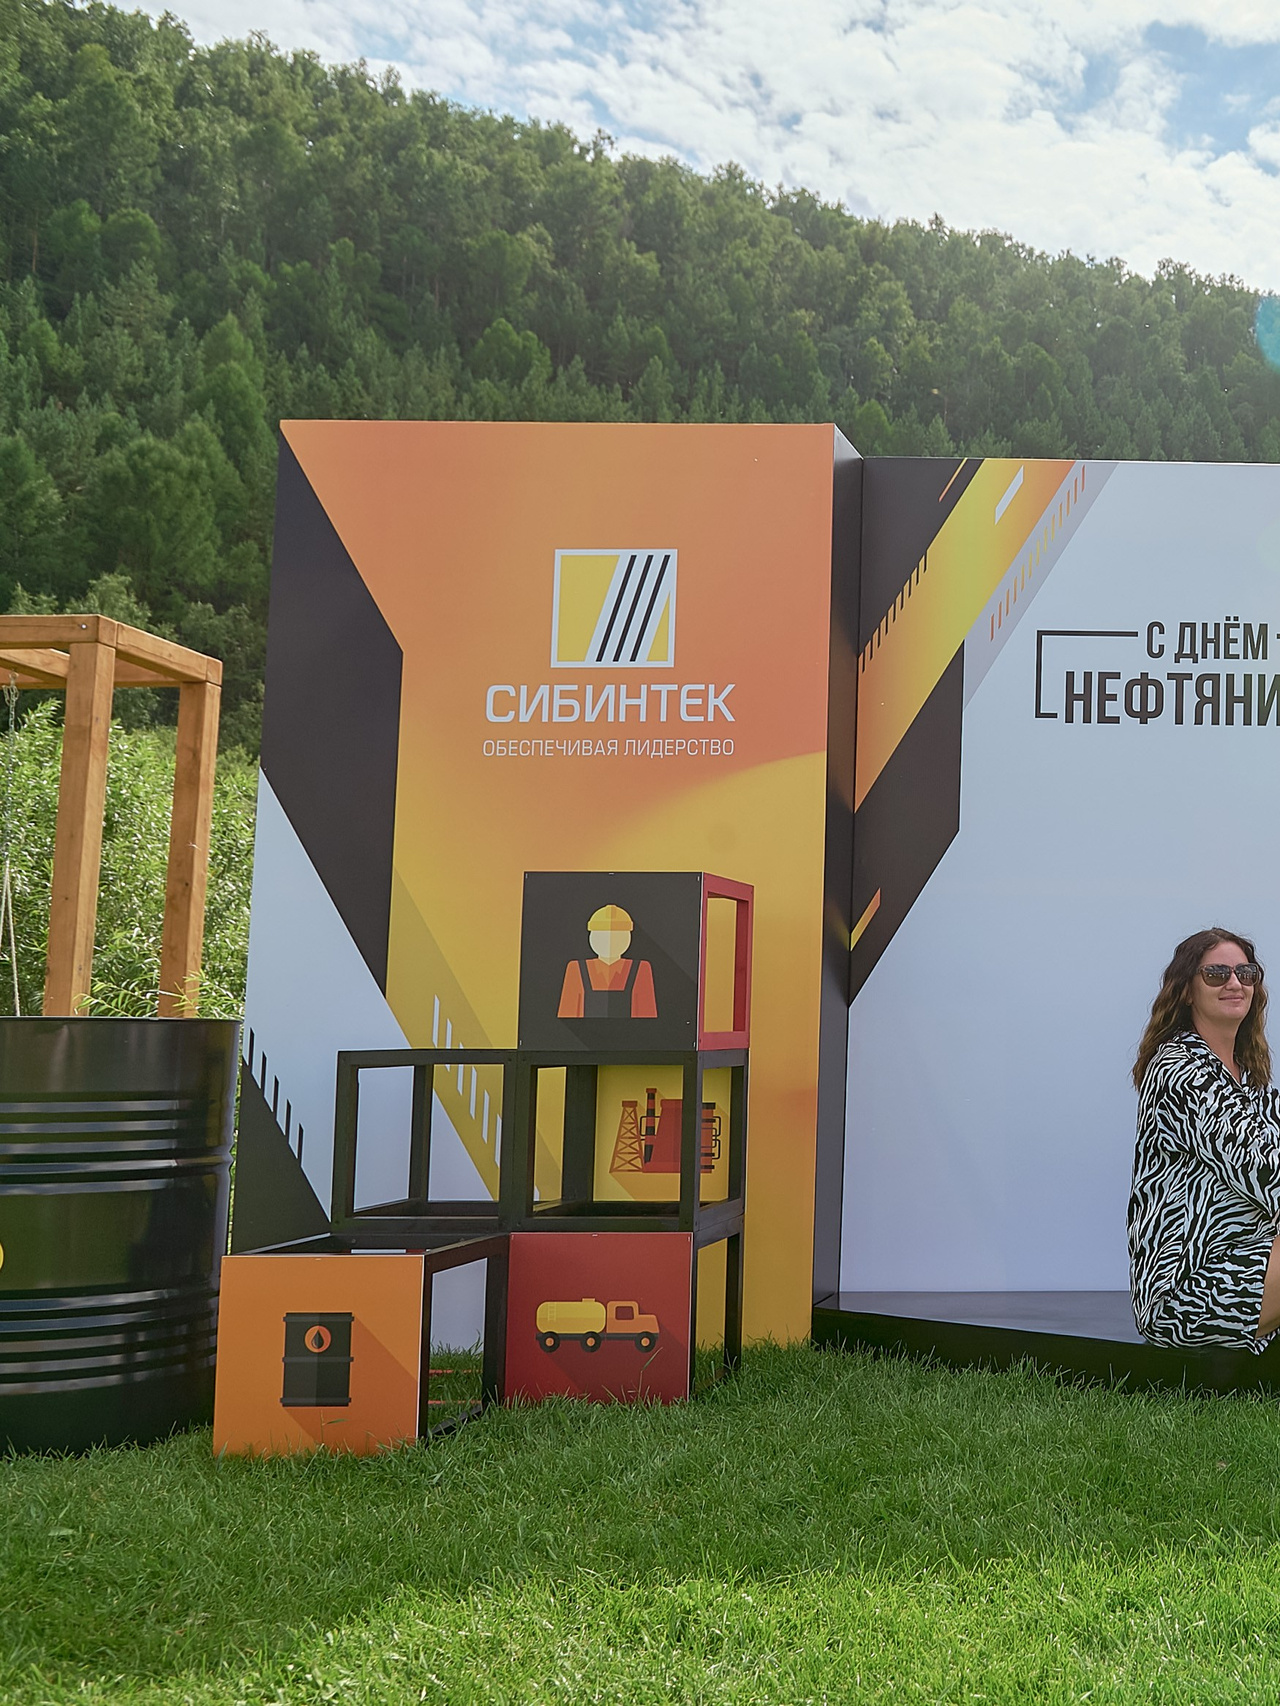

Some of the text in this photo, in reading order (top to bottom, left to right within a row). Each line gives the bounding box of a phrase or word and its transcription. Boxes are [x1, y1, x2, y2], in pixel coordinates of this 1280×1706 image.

[1146, 615, 1269, 664] С ДНЁМ
[485, 683, 736, 723] СИБИНТЕК
[482, 738, 735, 759] ОБЕСПЕЧИВАЯ ЛИДЕРСТВО
